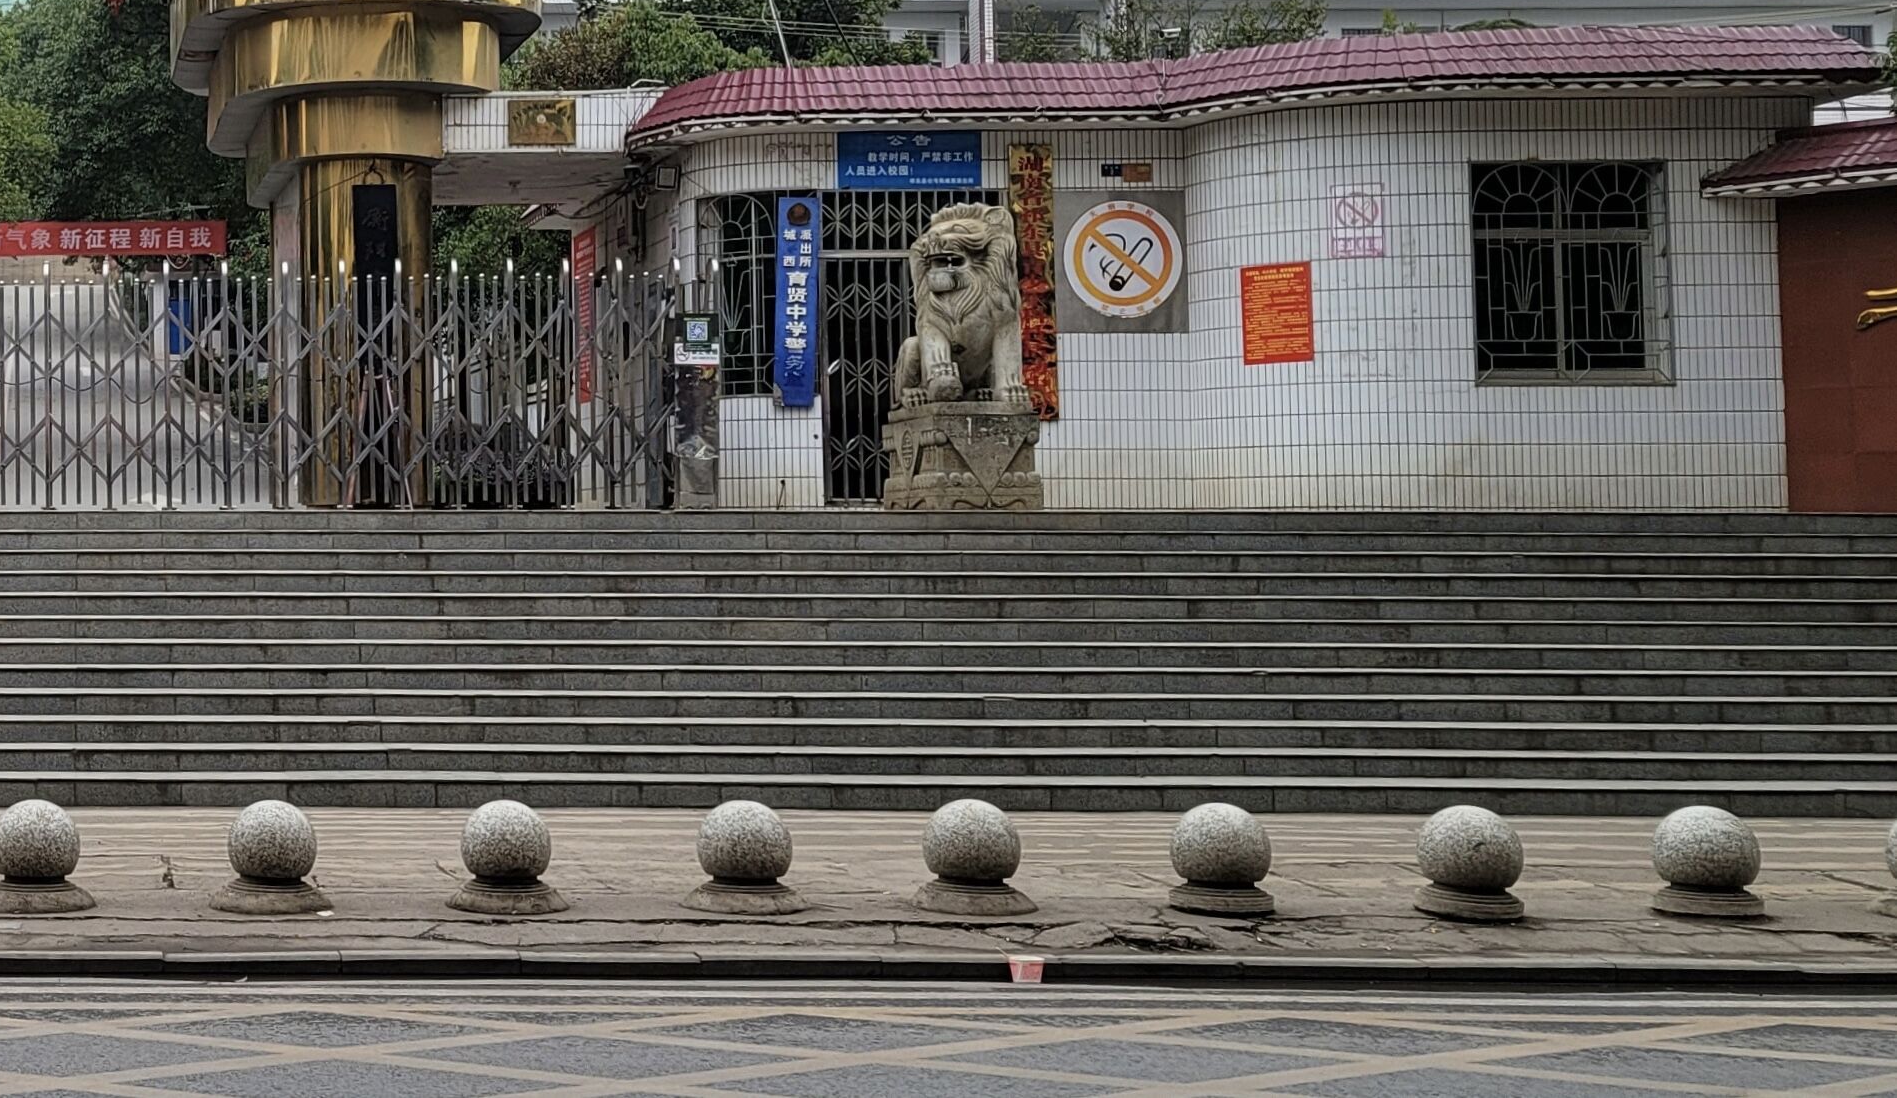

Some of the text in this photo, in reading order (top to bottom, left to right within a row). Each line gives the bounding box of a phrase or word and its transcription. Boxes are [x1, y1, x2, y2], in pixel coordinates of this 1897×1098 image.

[887, 134, 931, 146] 公告
[59, 228, 132, 249] 新征程
[139, 226, 212, 249] 新自我
